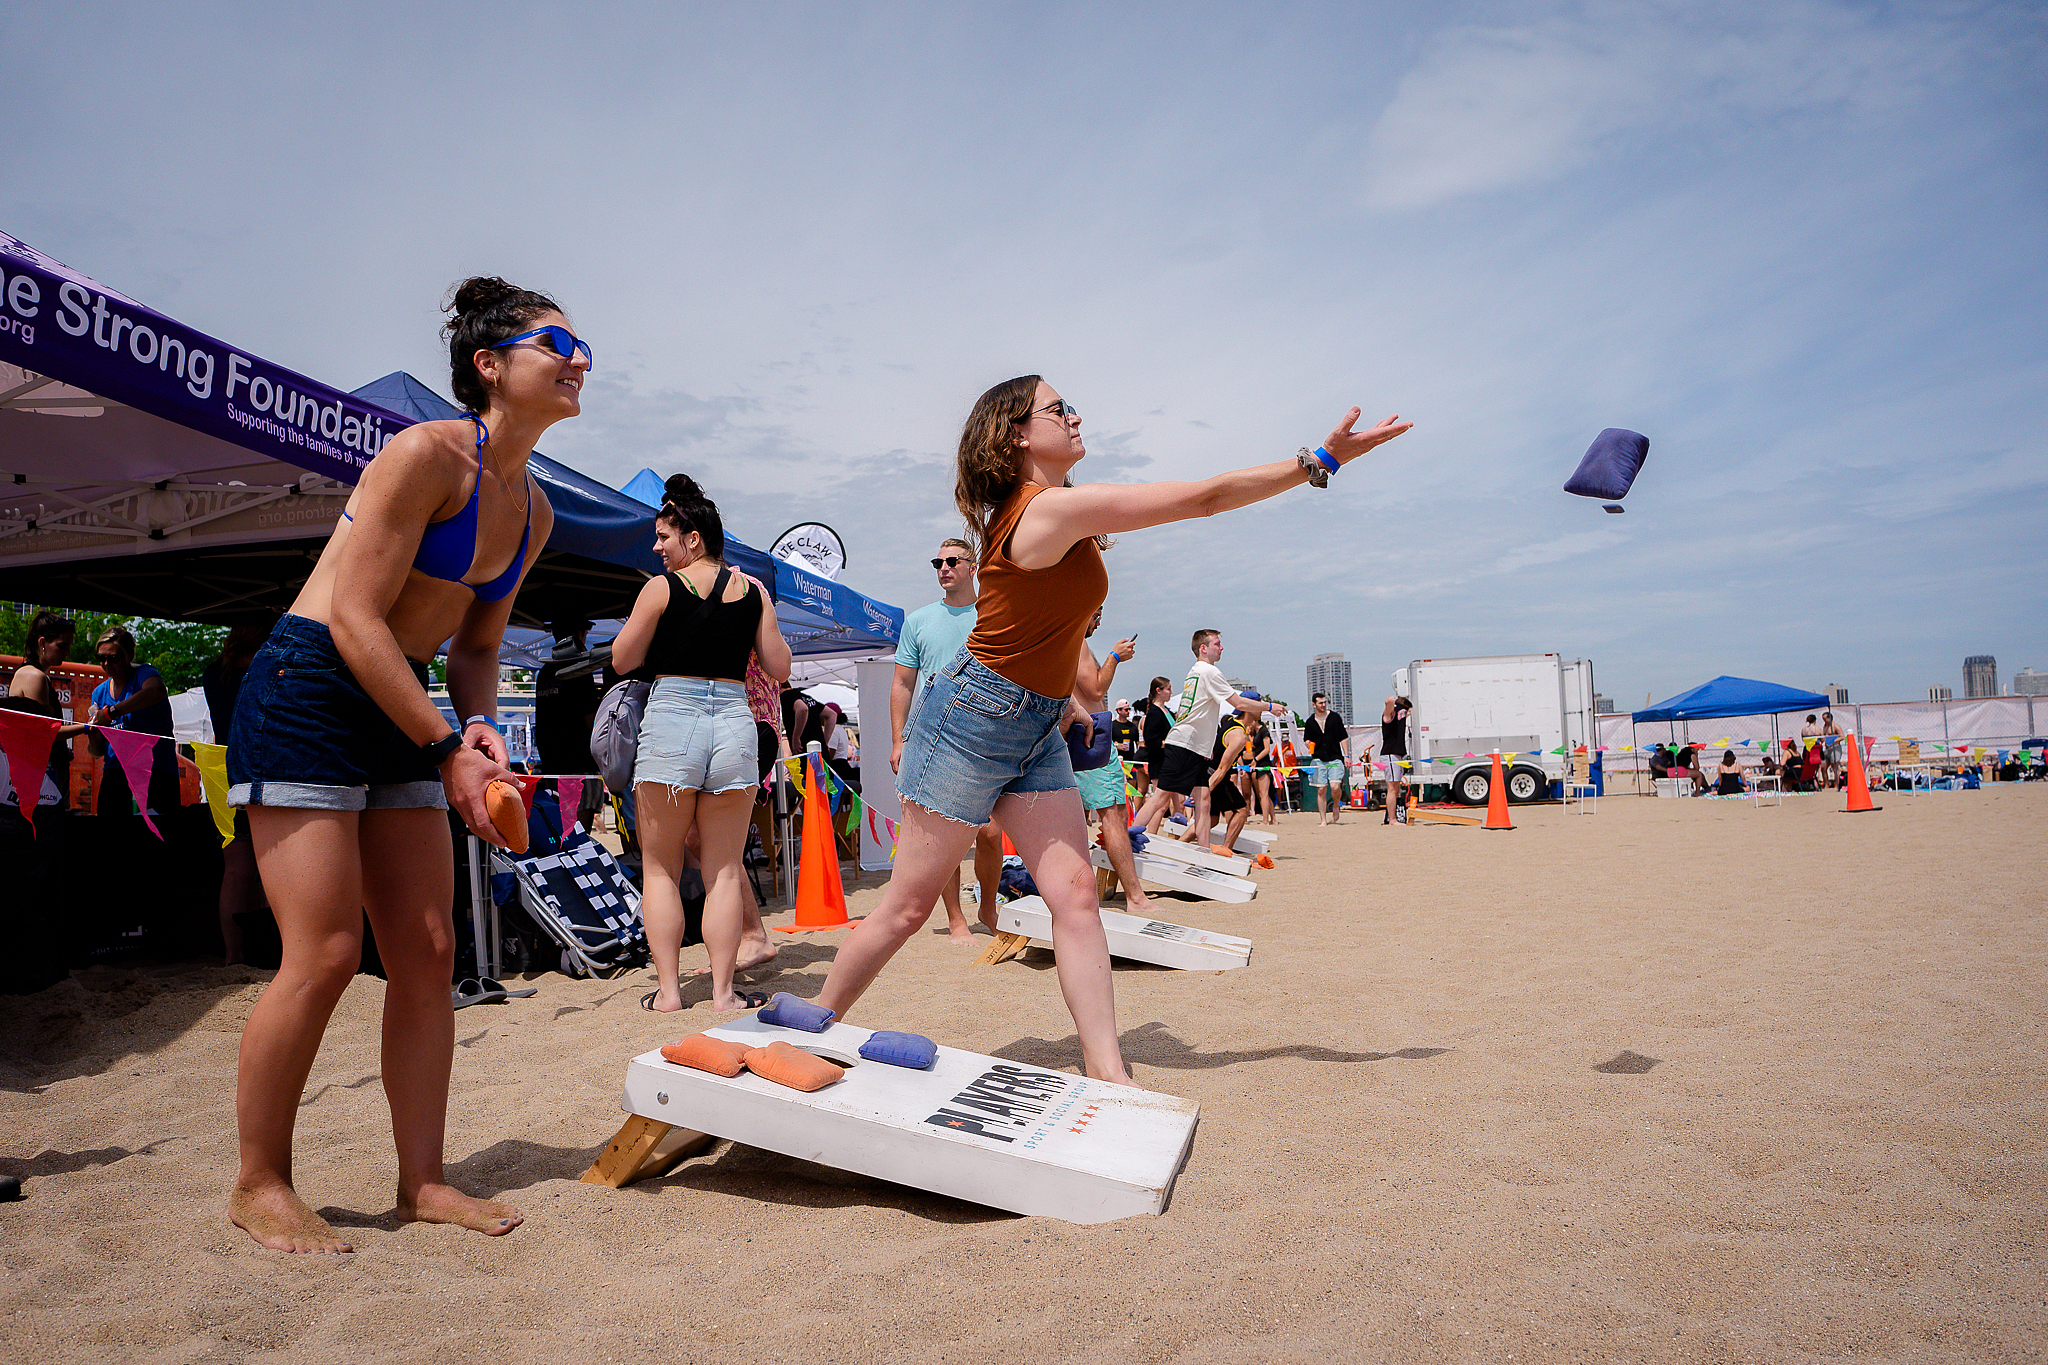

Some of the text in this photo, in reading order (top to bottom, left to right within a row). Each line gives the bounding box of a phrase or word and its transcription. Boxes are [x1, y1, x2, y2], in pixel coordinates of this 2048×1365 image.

[56, 281, 214, 399] Strong
[227, 402, 286, 443] Supporting
[287, 426, 304, 446] the
[305, 433, 342, 461] families
[344, 450, 353, 465] of
[778, 537, 832, 562] ITE CLAW
[792, 570, 832, 602] Waterman
[923, 1064, 1069, 1143] PLAYERS
[1023, 1128, 1050, 1149] SPORT
[1049, 1100, 1075, 1121] SOCIAL
[1068, 1081, 1089, 1099] GROUP
